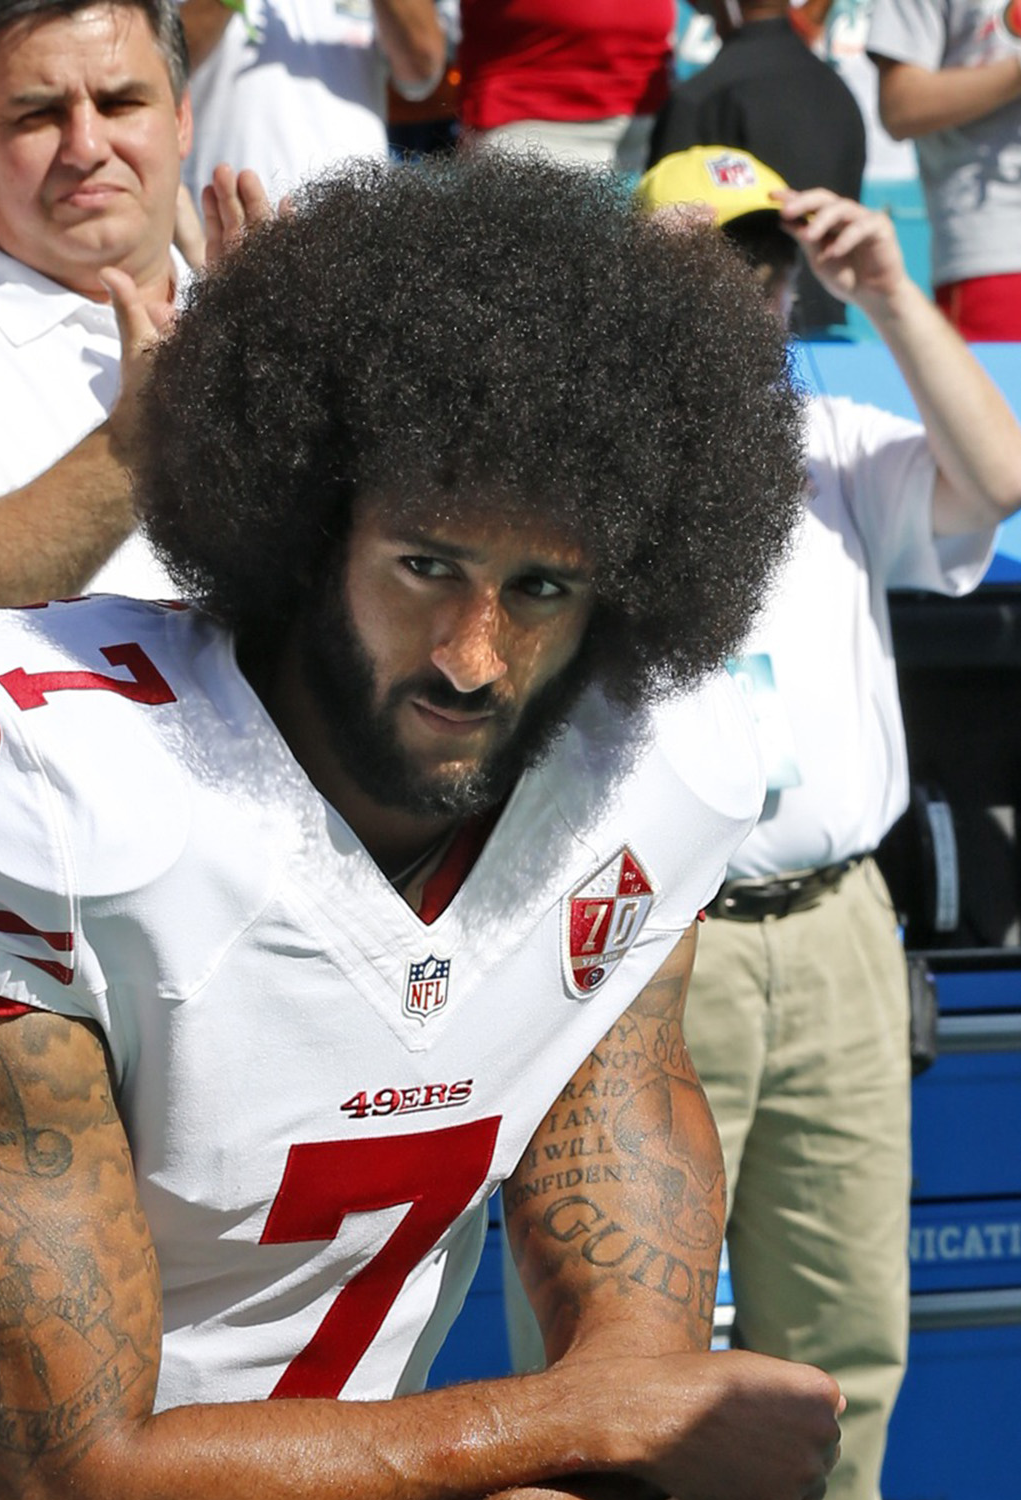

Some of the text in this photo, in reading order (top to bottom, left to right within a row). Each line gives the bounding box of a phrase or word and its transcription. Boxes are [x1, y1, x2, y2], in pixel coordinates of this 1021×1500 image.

[581, 900, 640, 952] 70
[581, 951, 620, 967] YEARS
[410, 980, 444, 1010] NFL
[340, 1078, 474, 1119] 49ERS
[564, 1105, 608, 1129] AM
[545, 1135, 614, 1162] WILL
[511, 1163, 641, 1205] ONFIDENT
[259, 1115, 503, 1401] 7
